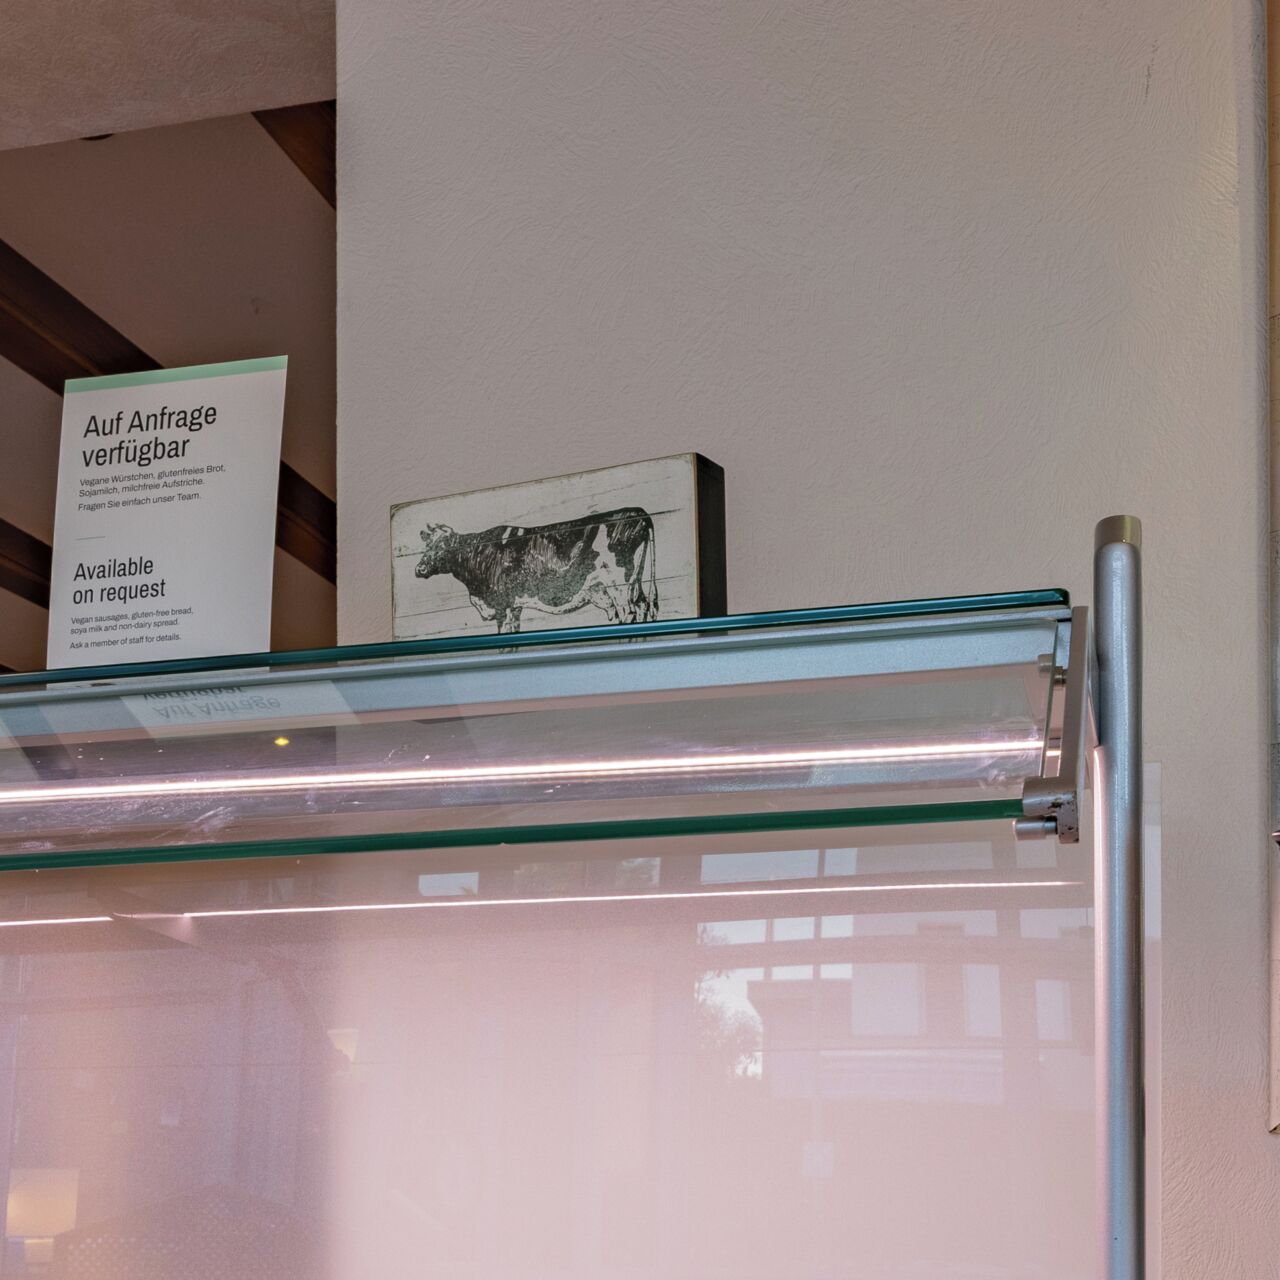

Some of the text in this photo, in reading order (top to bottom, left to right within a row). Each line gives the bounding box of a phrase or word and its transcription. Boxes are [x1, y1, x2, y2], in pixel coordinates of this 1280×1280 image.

[83, 405, 217, 438] Auf Anfrage
[82, 436, 190, 467] verfügbar
[80, 464, 226, 487] Vegane Würstchen, glutenfreies Brot,
[78, 487, 120, 498] Sojamilch,
[121, 481, 161, 493] milchfreie
[78, 502, 106, 511] Fragen
[107, 499, 120, 509] Sie
[121, 496, 151, 507] einfach
[152, 494, 175, 504] unser
[73, 556, 153, 581] Available
[73, 578, 166, 605] on request
[70, 627, 87, 635] soya
[88, 625, 102, 633] milk
[103, 623, 117, 631] and
[118, 620, 151, 631] non-dairy
[71, 616, 93, 626] Vegan
[131, 610, 170, 621] gluten-free
[69, 641, 83, 649] Ask
[90, 639, 119, 648] member
[120, 637, 128, 645] of
[128, 635, 144, 645] staff
[145, 635, 155, 643] for
